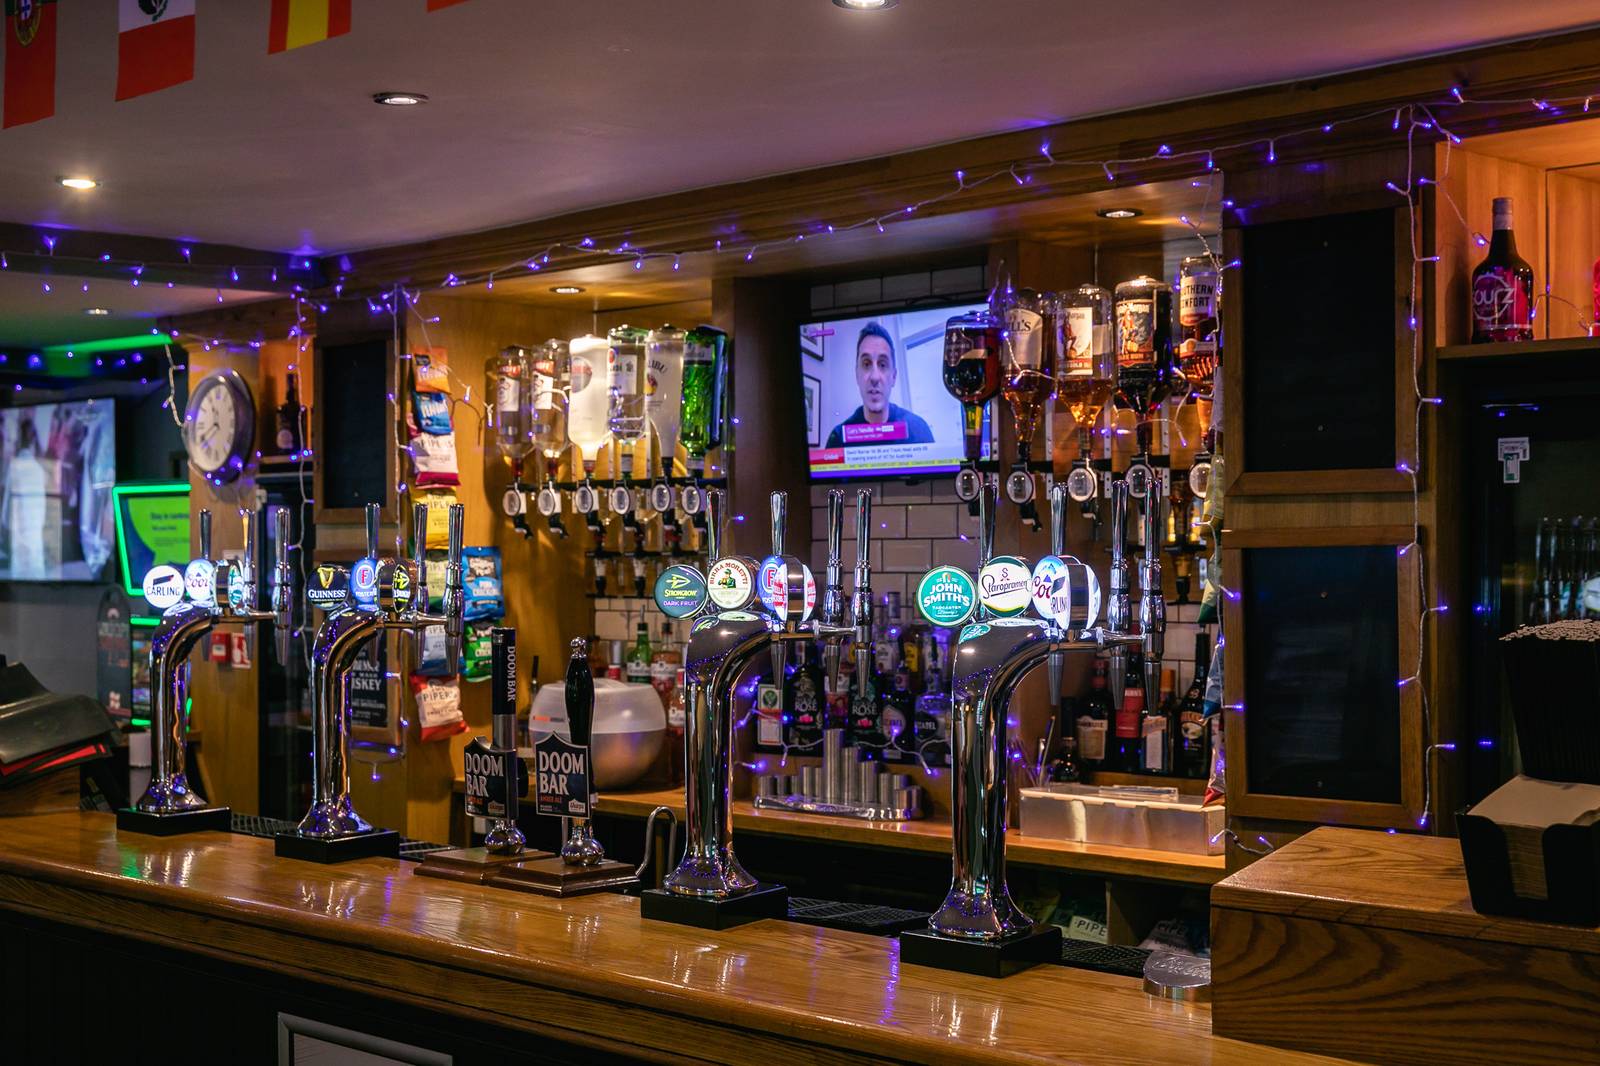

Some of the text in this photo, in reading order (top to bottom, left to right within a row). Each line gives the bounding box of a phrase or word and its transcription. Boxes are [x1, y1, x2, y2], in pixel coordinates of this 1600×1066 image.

[1472, 287, 1515, 311] ourz
[709, 562, 748, 585] BIRRA MORETTI
[146, 586, 180, 597] CARLING
[308, 589, 347, 599] GUINNESS
[930, 581, 963, 595] JOHN
[923, 592, 970, 608] SMITH'S
[507, 645, 516, 702] DOOM BAR
[352, 679, 381, 691] ISKEY
[465, 751, 504, 777] DOOM
[538, 751, 585, 775] DOOM
[466, 775, 489, 797] BAR
[540, 774, 569, 796] BAR
[1075, 919, 1107, 937] PIPE
